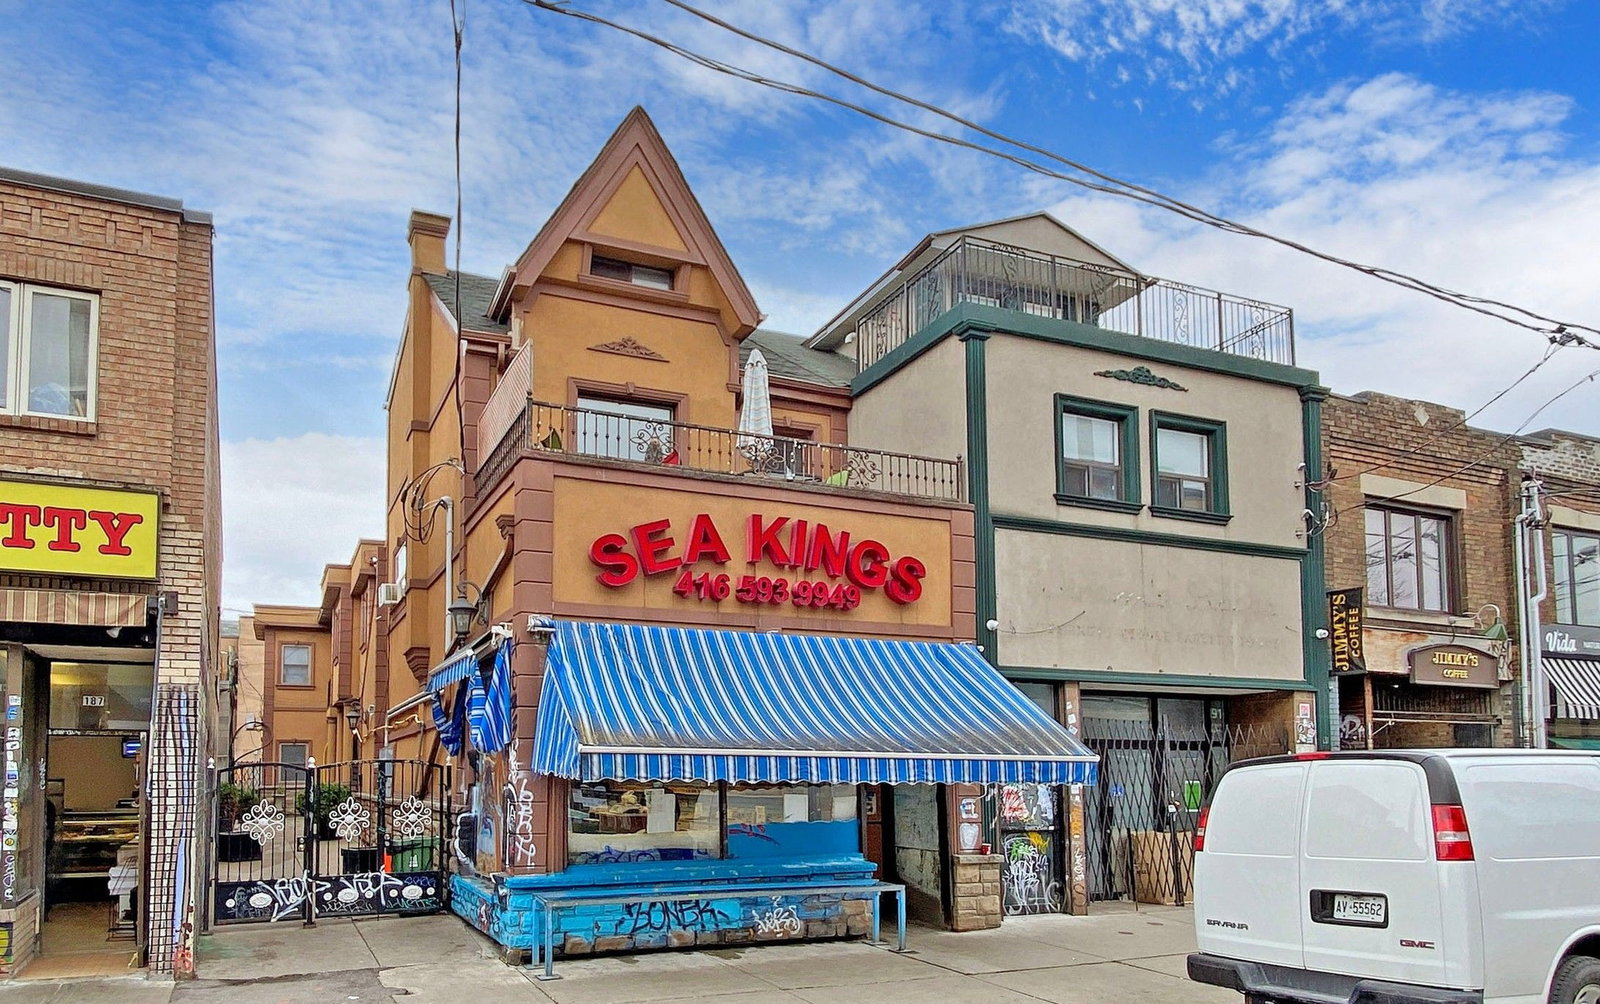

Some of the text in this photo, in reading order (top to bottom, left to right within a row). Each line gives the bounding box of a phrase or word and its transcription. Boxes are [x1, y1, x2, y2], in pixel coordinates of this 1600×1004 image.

[588, 513, 732, 587] SEA
[746, 513, 926, 605] KINGS
[673, 571, 861, 612] 416 593 9949
[1332, 593, 1350, 672] JIMMY'S
[1348, 607, 1361, 658] COFFEE
[1545, 630, 1577, 652] Vida
[1432, 651, 1479, 667] JIMMY'S
[1443, 668, 1469, 679] COFFEE
[84, 696, 104, 706] 187
[1352, 901, 1383, 917] 55562
[1399, 939, 1435, 950] GMC
